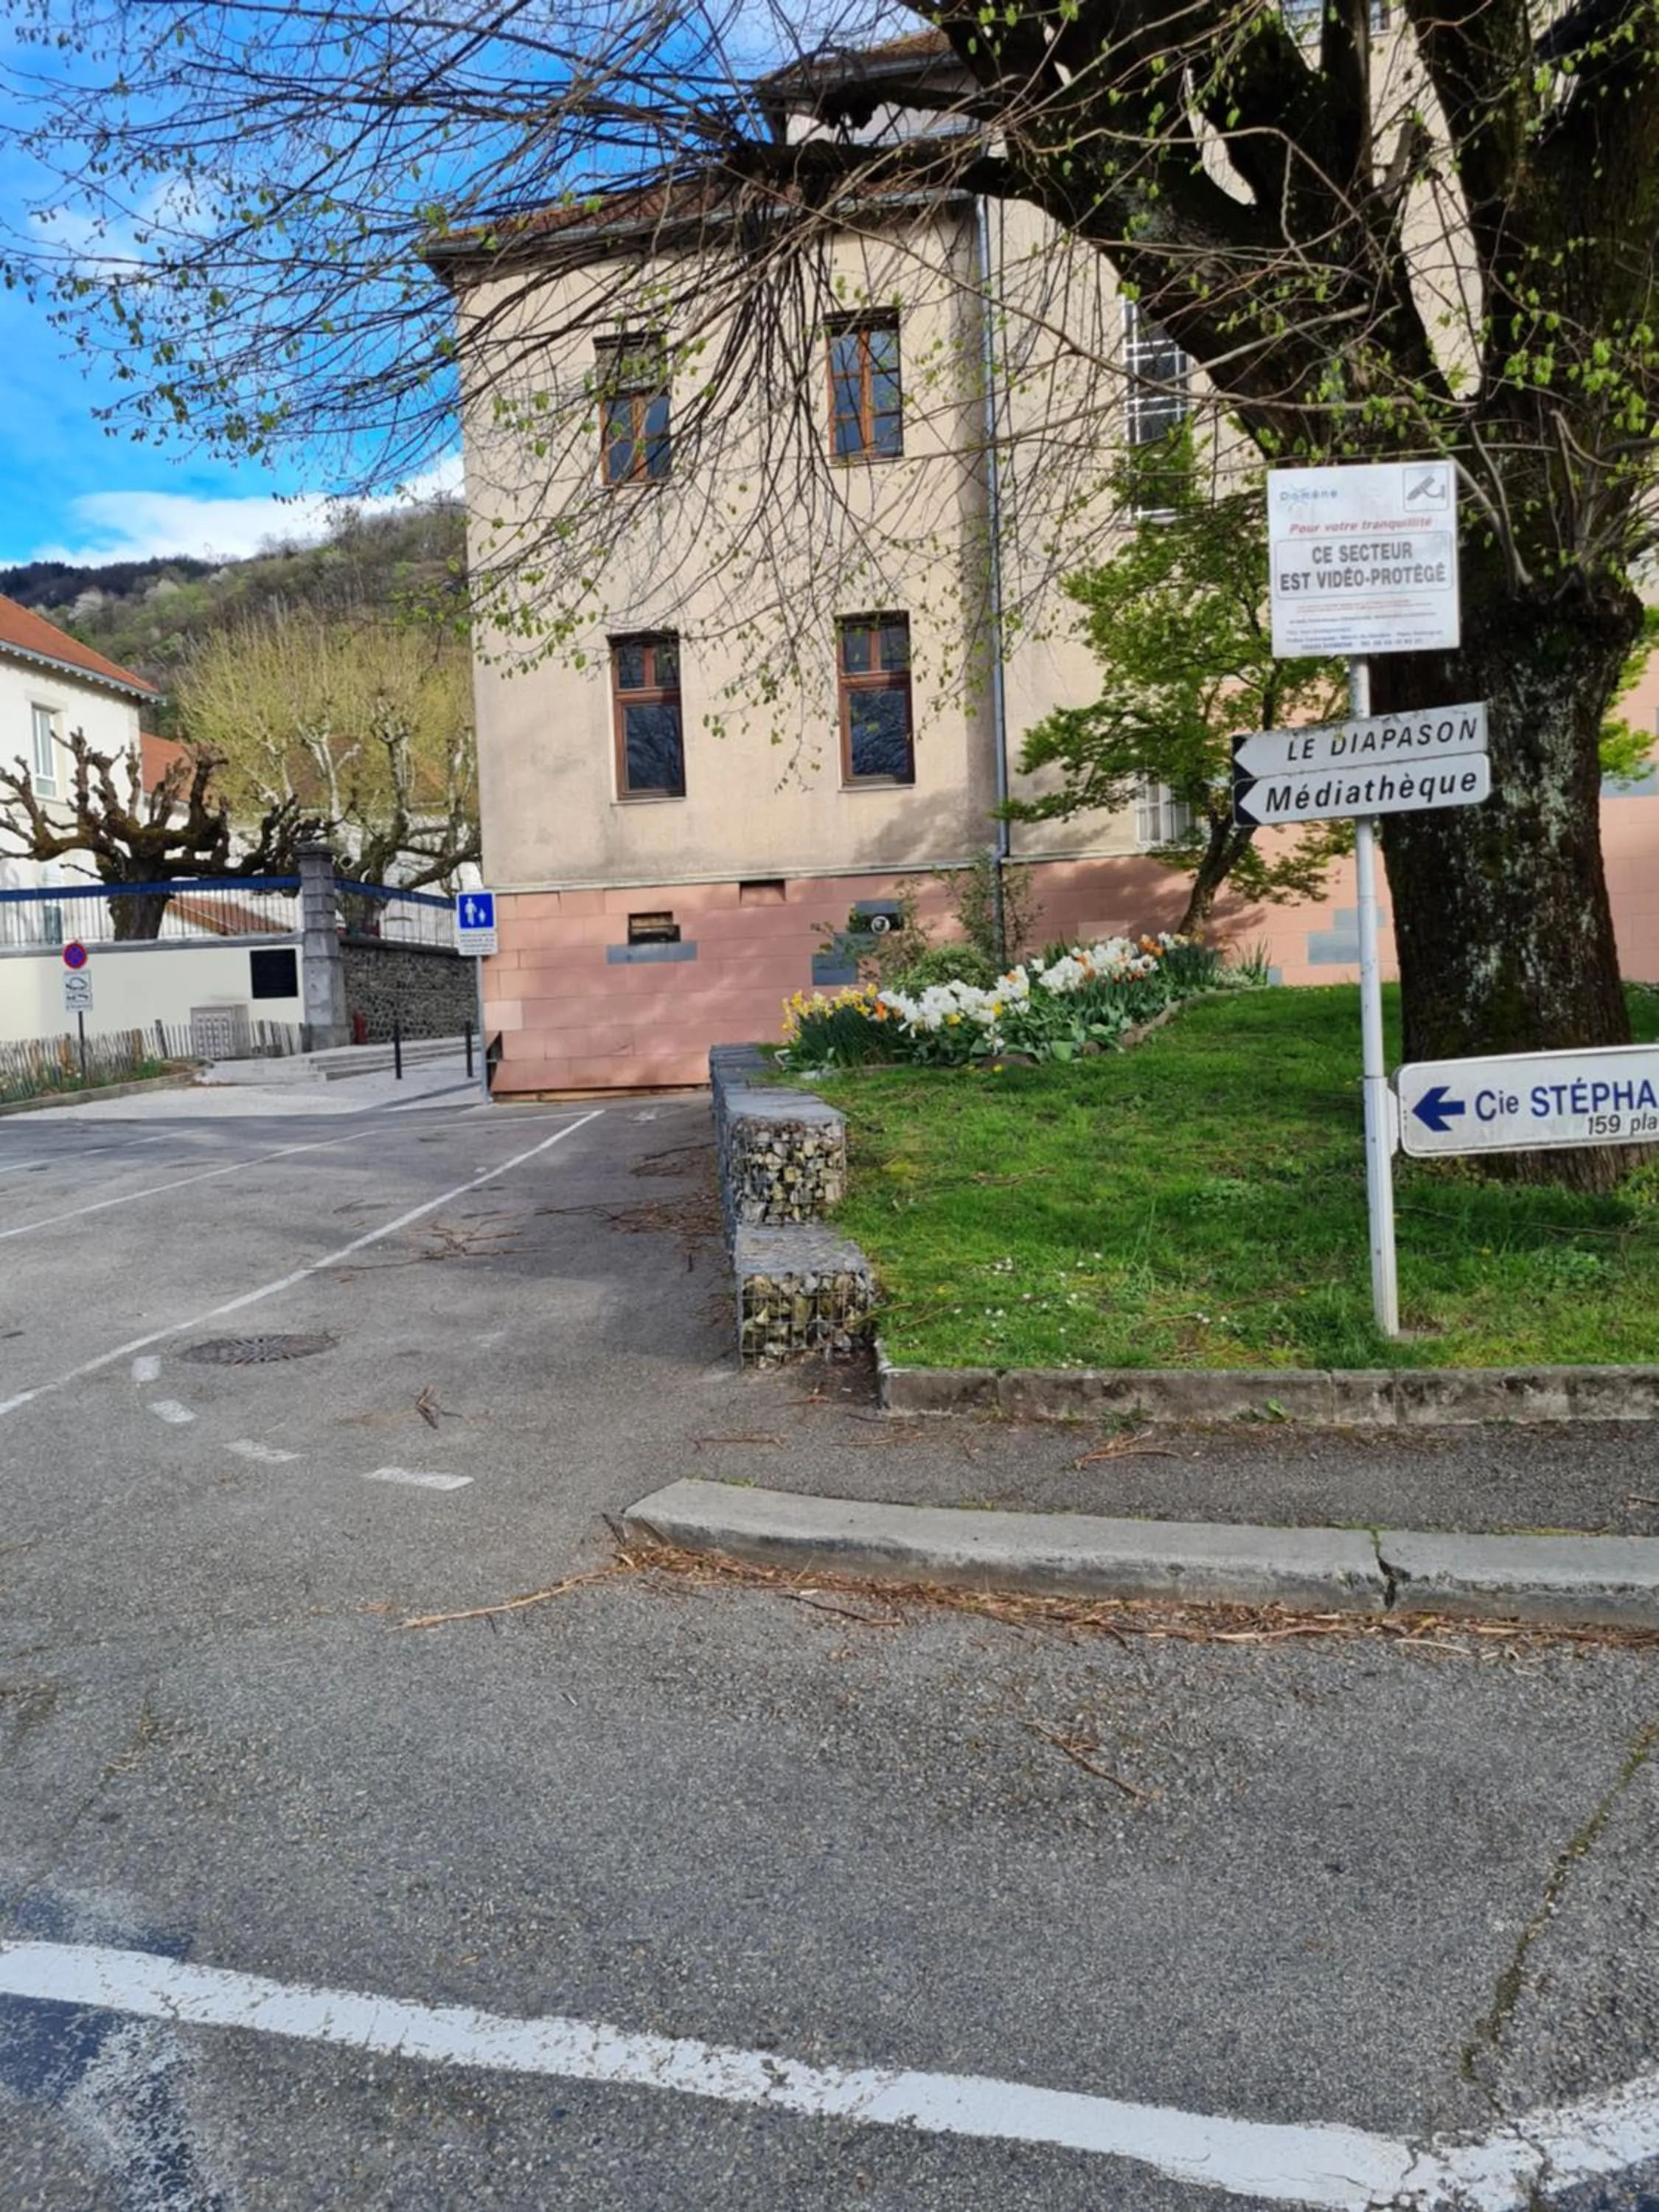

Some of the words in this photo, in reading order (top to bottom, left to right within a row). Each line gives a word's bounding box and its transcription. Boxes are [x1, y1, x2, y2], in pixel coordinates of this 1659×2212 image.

[1290, 523, 1319, 534] Pour
[1325, 521, 1358, 532] votre
[1312, 546, 1332, 564] CE
[1338, 542, 1413, 563] SECTEUR
[1281, 572, 1310, 591] EST
[1287, 738, 1315, 761] LE
[1331, 718, 1477, 757] DIAPASON
[1265, 772, 1477, 813] Médiathèque
[1475, 1090, 1519, 1121] Cie
[1531, 1077, 1658, 1118] STÉPHA
[1587, 1114, 1621, 1135] 159
[1630, 1112, 1658, 1137] pla
